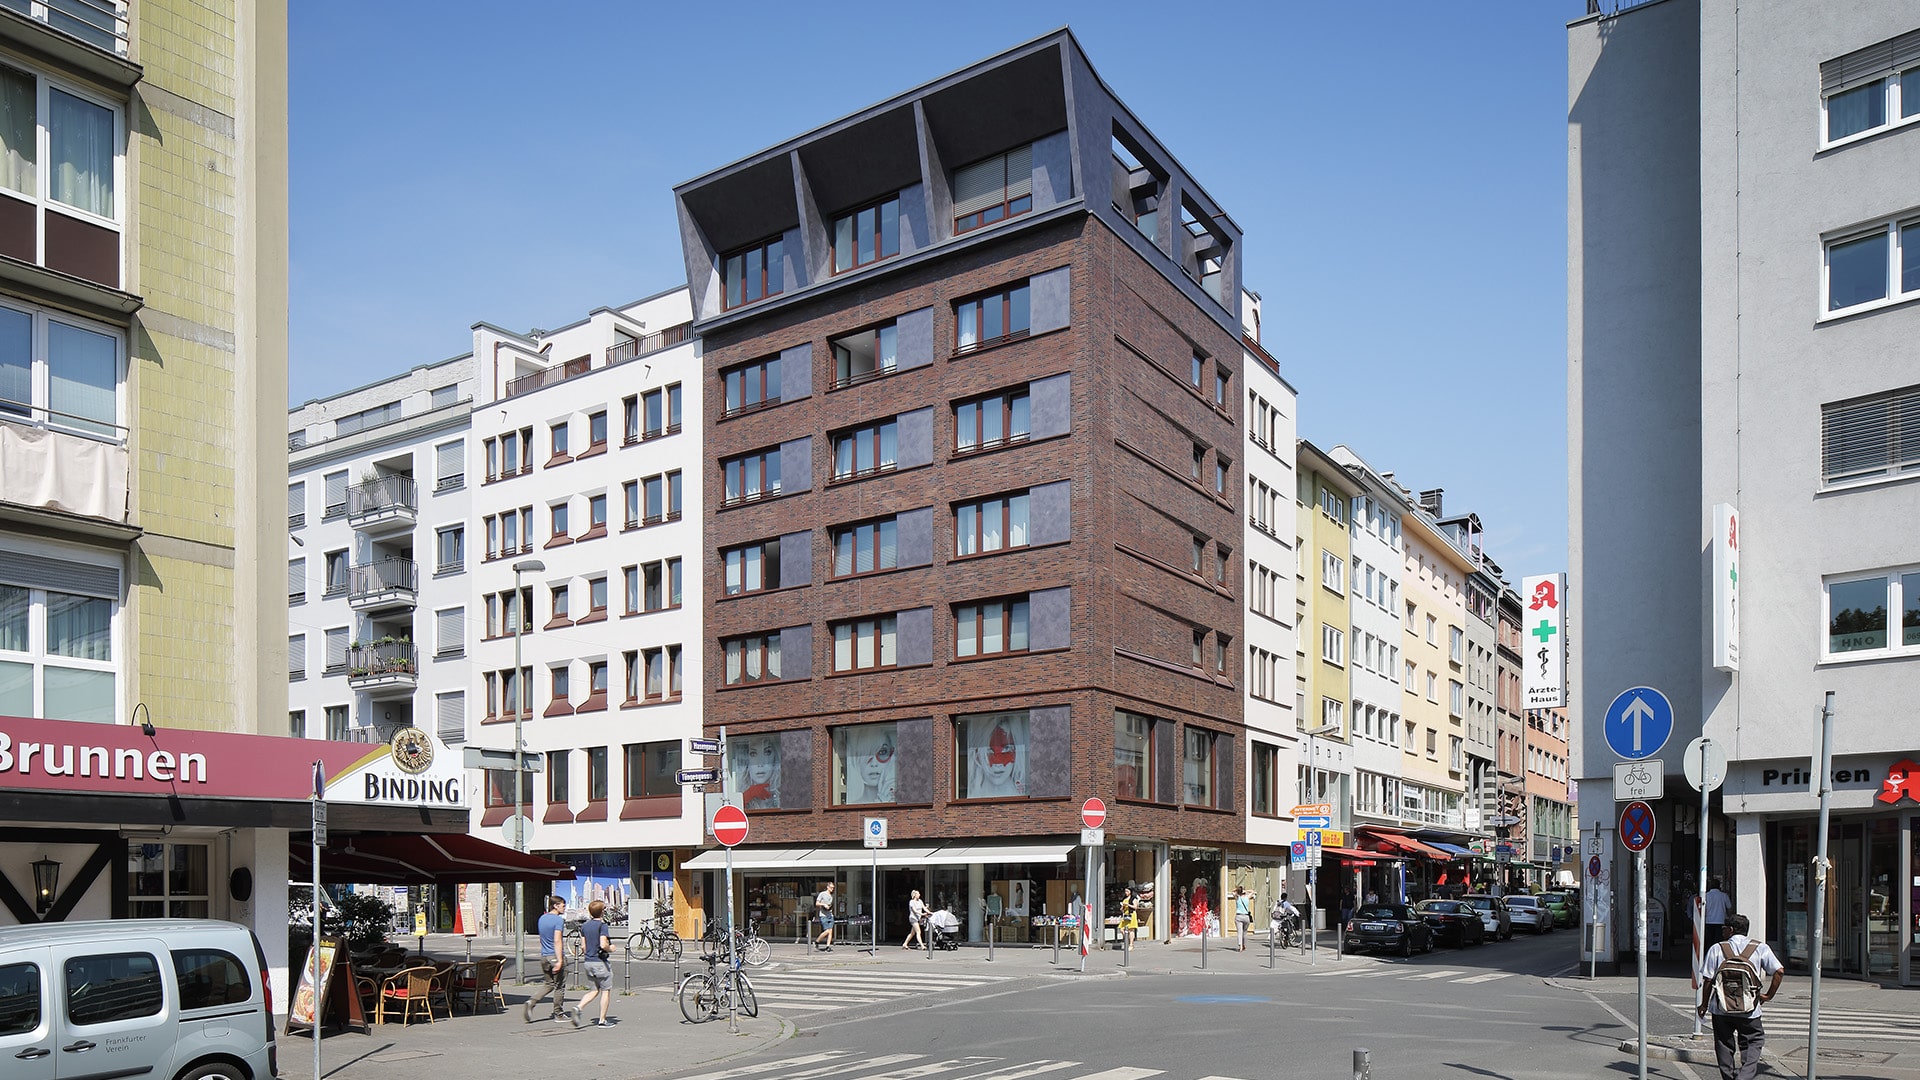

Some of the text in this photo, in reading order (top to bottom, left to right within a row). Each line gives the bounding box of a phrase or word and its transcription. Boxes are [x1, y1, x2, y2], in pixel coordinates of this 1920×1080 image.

[1841, 636, 1875, 647] HNO
[1528, 686, 1560, 694] Ärzte-
[1530, 695, 1558, 703] Haus
[1763, 768, 1870, 786] Prien
[365, 773, 459, 804] BINDING
[1630, 787, 1646, 795] frei
[105, 1035, 147, 1045] Frankfurter
[105, 1045, 130, 1053] Verein
